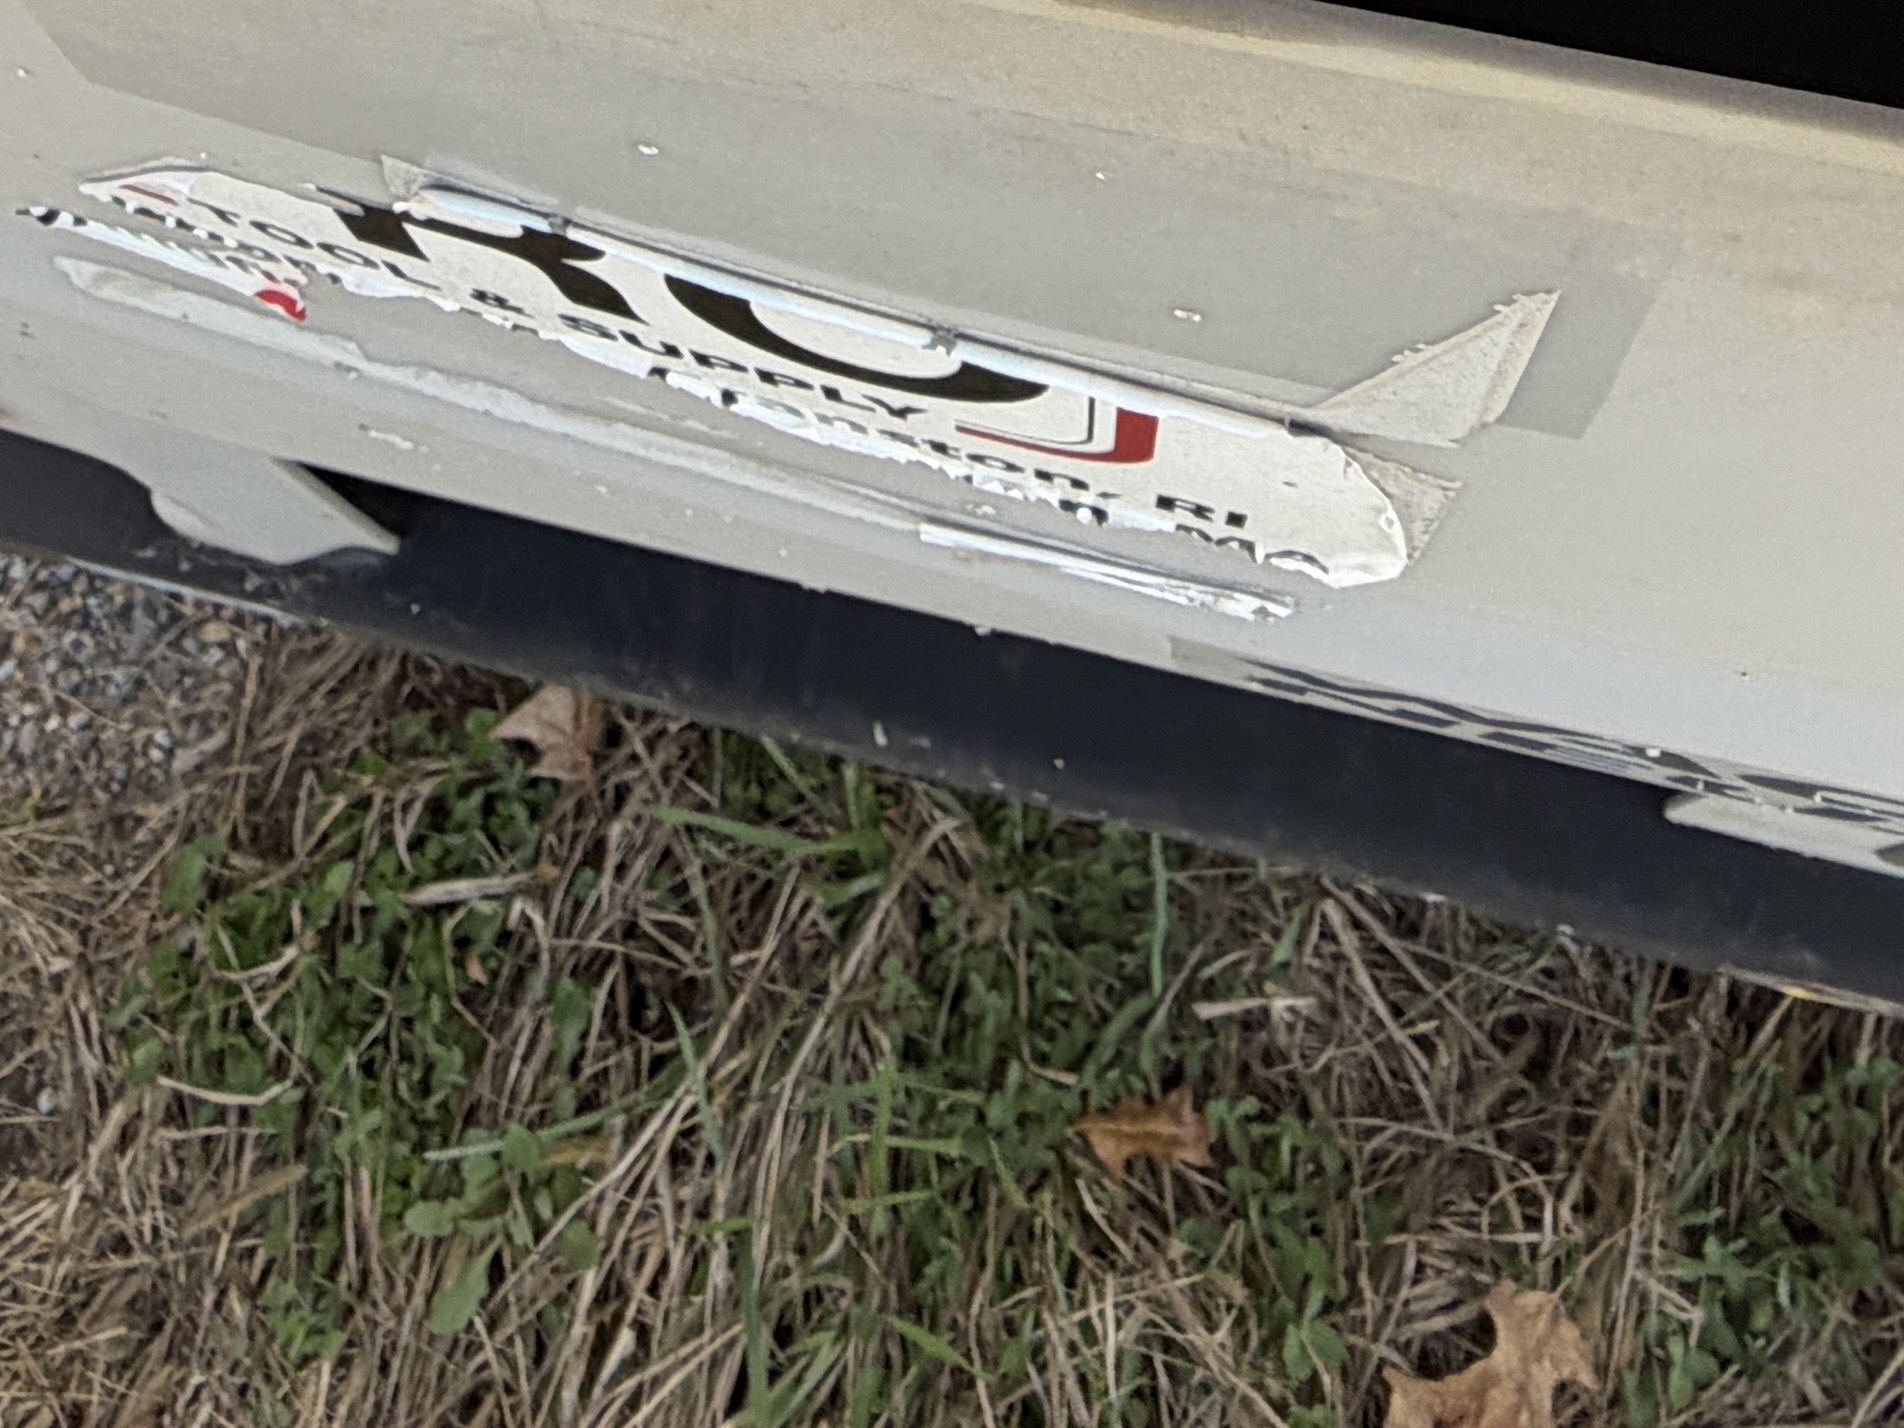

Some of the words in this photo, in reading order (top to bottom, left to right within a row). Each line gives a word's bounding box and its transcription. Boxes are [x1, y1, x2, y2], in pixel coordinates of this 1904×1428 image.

[186, 198, 440, 291] TOOL
[470, 287, 531, 316] &
[557, 313, 928, 422] SUPPLY
[649, 367, 1120, 500] ranston,
[1156, 493, 1247, 529] RI
